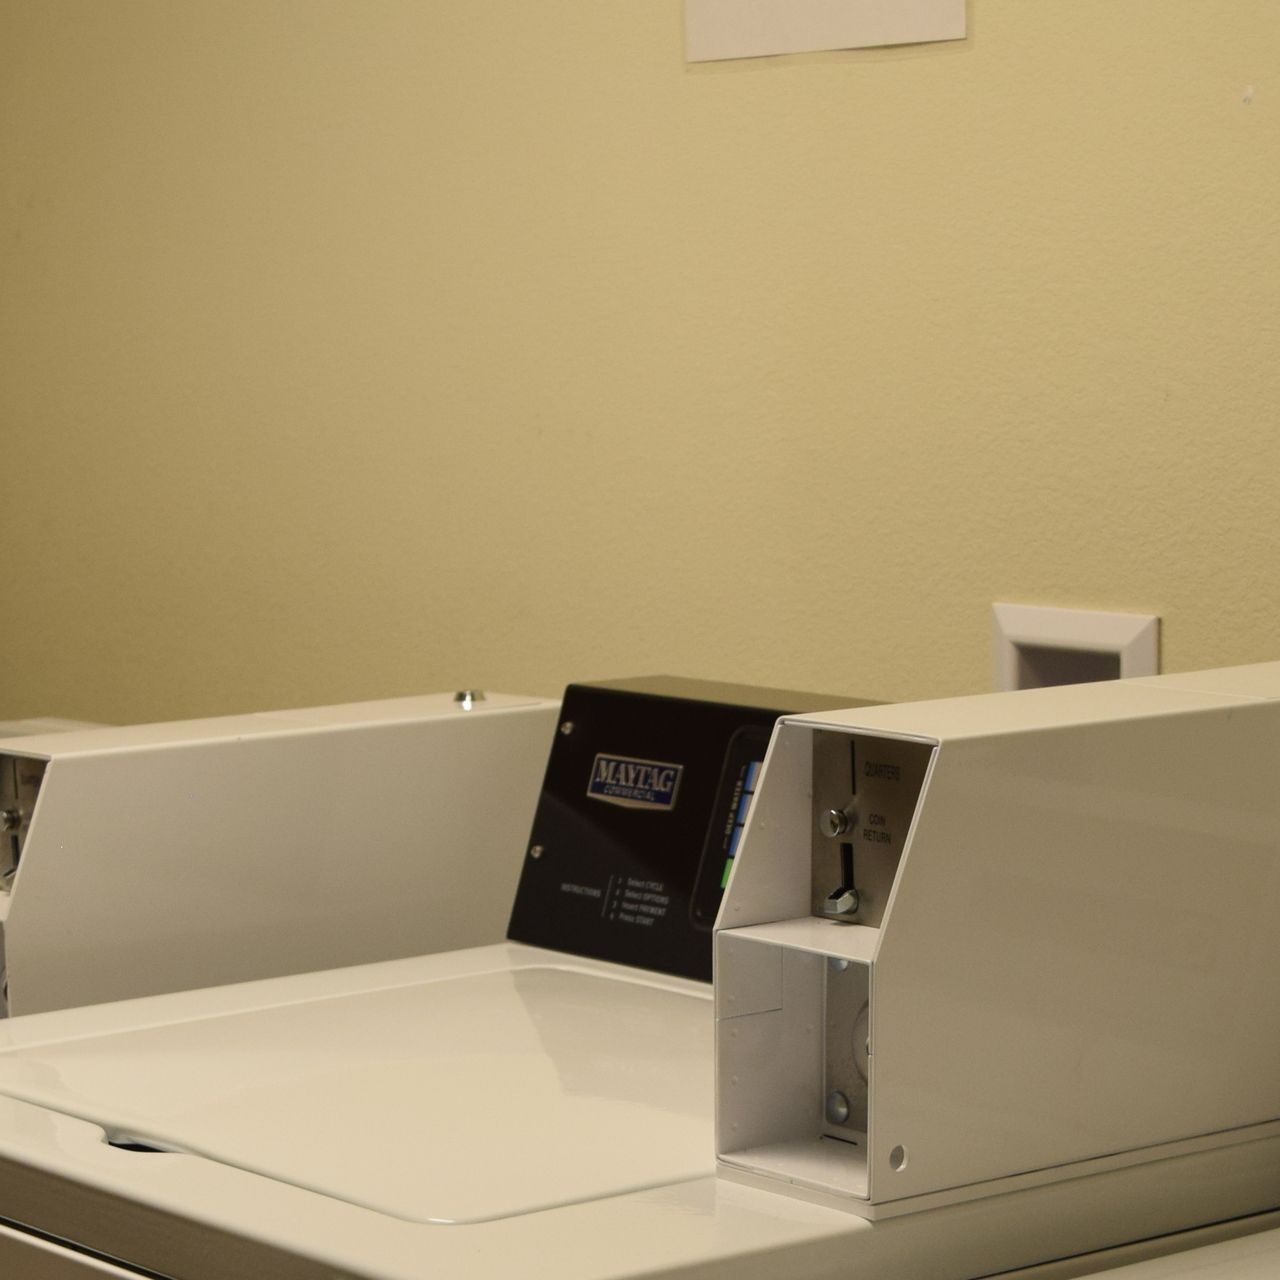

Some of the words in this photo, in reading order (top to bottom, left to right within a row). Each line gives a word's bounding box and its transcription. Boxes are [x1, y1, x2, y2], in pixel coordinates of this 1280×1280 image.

[595, 759, 675, 792] MAYTAG
[864, 761, 901, 781] QUARTERS
[603, 784, 655, 802] COMMERCIAL
[868, 813, 887, 826] COIN
[863, 828, 892, 845] RETURN
